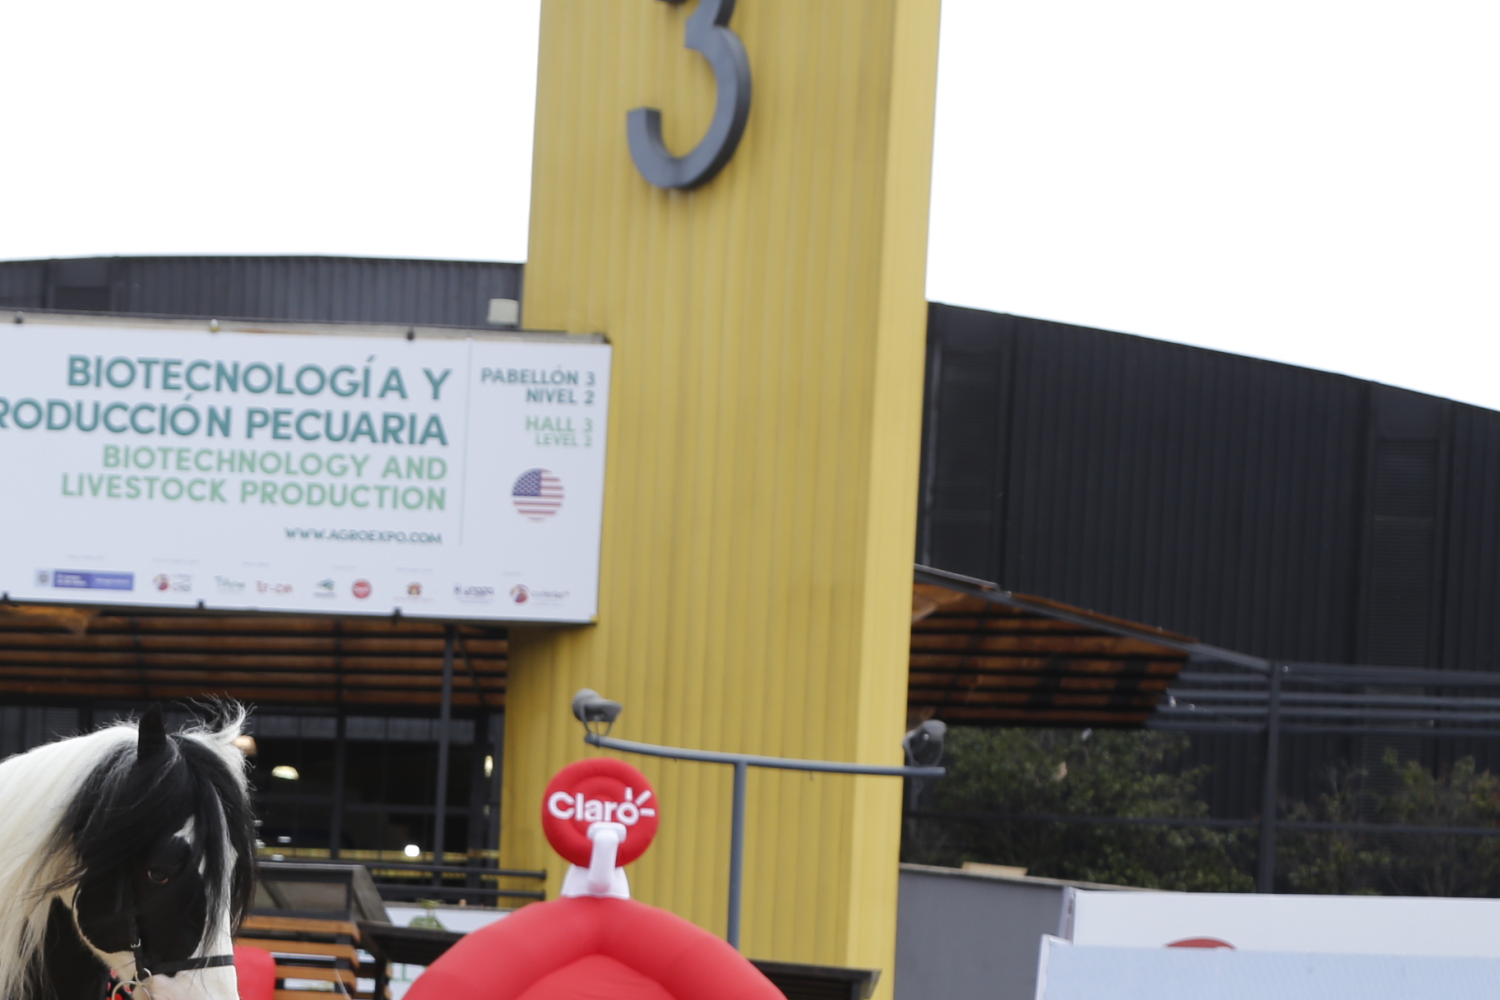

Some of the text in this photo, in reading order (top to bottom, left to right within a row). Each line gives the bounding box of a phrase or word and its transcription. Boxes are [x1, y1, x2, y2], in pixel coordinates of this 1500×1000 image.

[67, 354, 452, 401] BIOTECNOLOGÍA Y
[480, 364, 596, 387] PABELLÓN 3
[526, 387, 595, 405] NIVEL 2
[245, 406, 449, 446] PECUARIA
[525, 415, 593, 434] HALL 3
[534, 431, 579, 447] LEVEL
[102, 444, 448, 481] BIOTECHNOLOGY AND
[61, 472, 447, 511] LIVESTOCK PRODUCTION
[284, 526, 443, 545] WWW.AGROEXPO.COM
[548, 788, 642, 826] Claro
